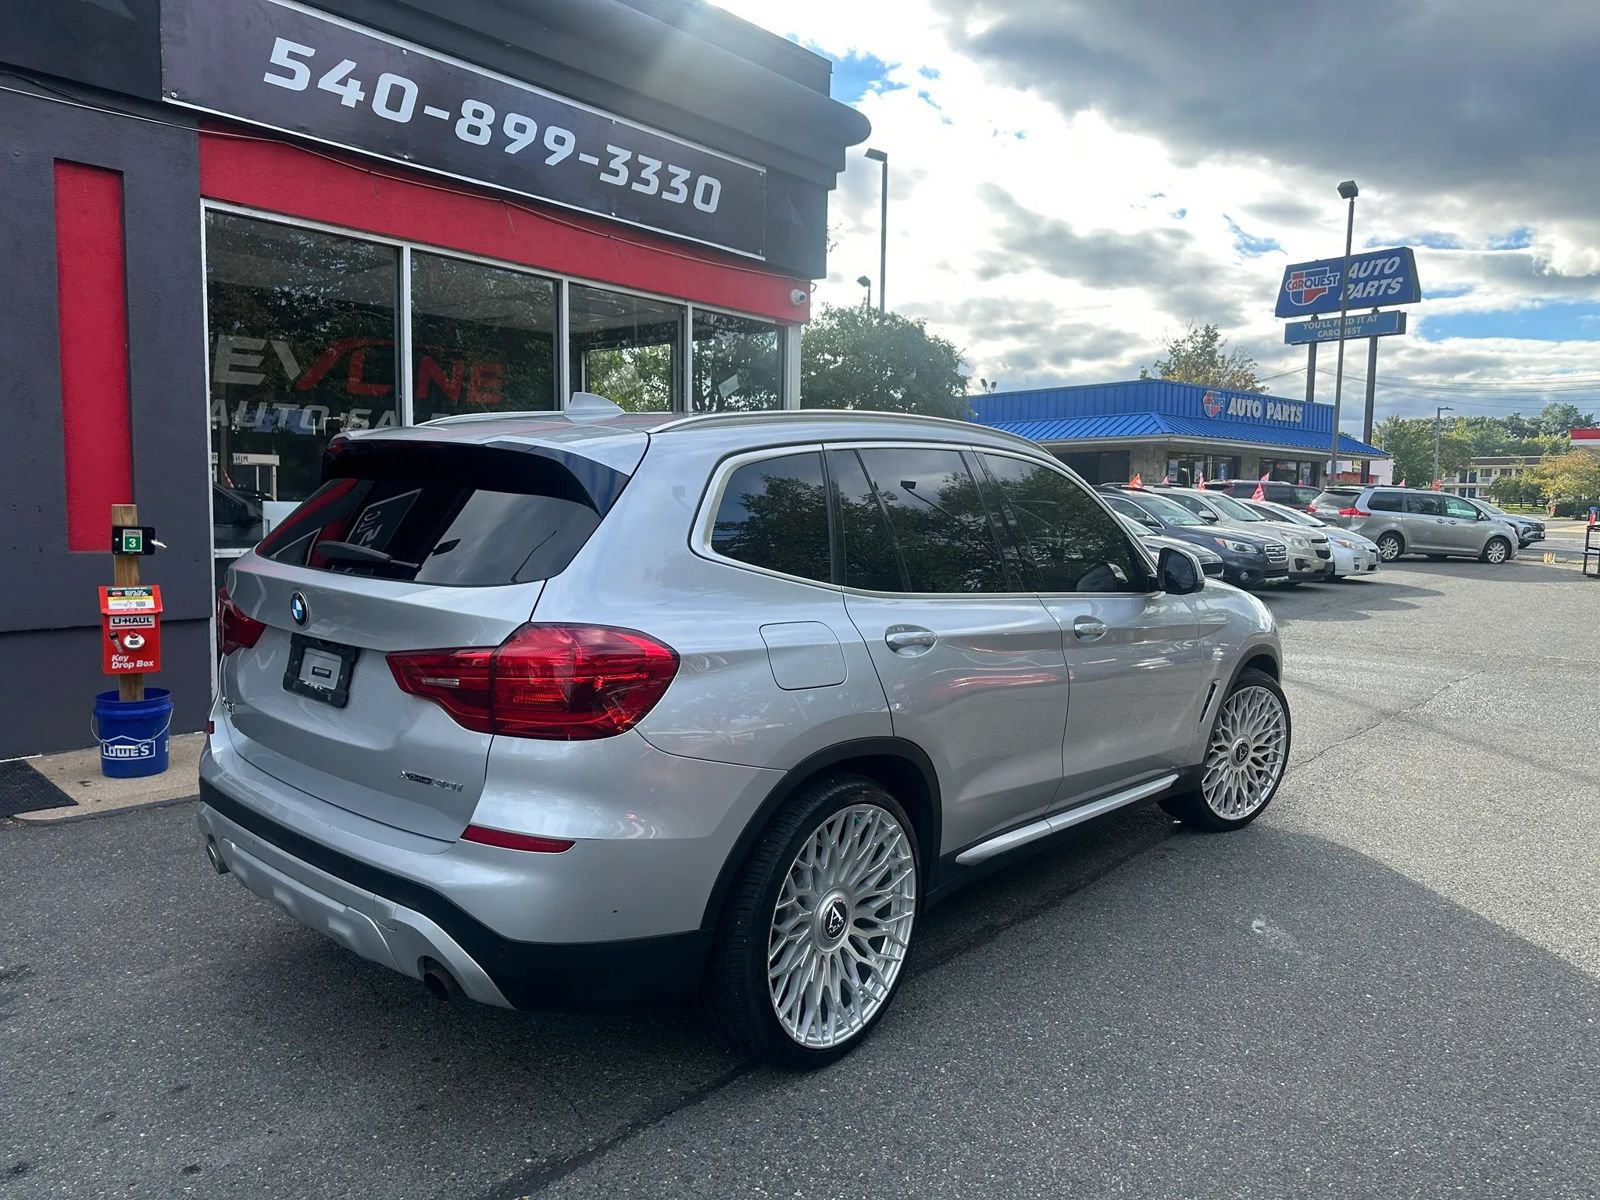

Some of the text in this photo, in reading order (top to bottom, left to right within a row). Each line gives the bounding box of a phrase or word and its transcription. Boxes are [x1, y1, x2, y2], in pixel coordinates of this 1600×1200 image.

[263, 36, 721, 214] 540-899-3330
[1348, 256, 1400, 279] AUTO
[1286, 274, 1339, 291] CARQUEST
[1338, 277, 1404, 301] PARTS
[1303, 319, 1331, 330] YOU'LL
[1357, 316, 1365, 324] IT
[1367, 315, 1378, 323] AT
[210, 399, 329, 431] AUTO
[1227, 397, 1262, 418] AUTO
[1266, 402, 1303, 423] PARTS
[129, 538, 137, 548] 3
[112, 654, 129, 662] Key
[112, 660, 154, 670] Drop Box
[102, 744, 149, 757] LOWE'S
